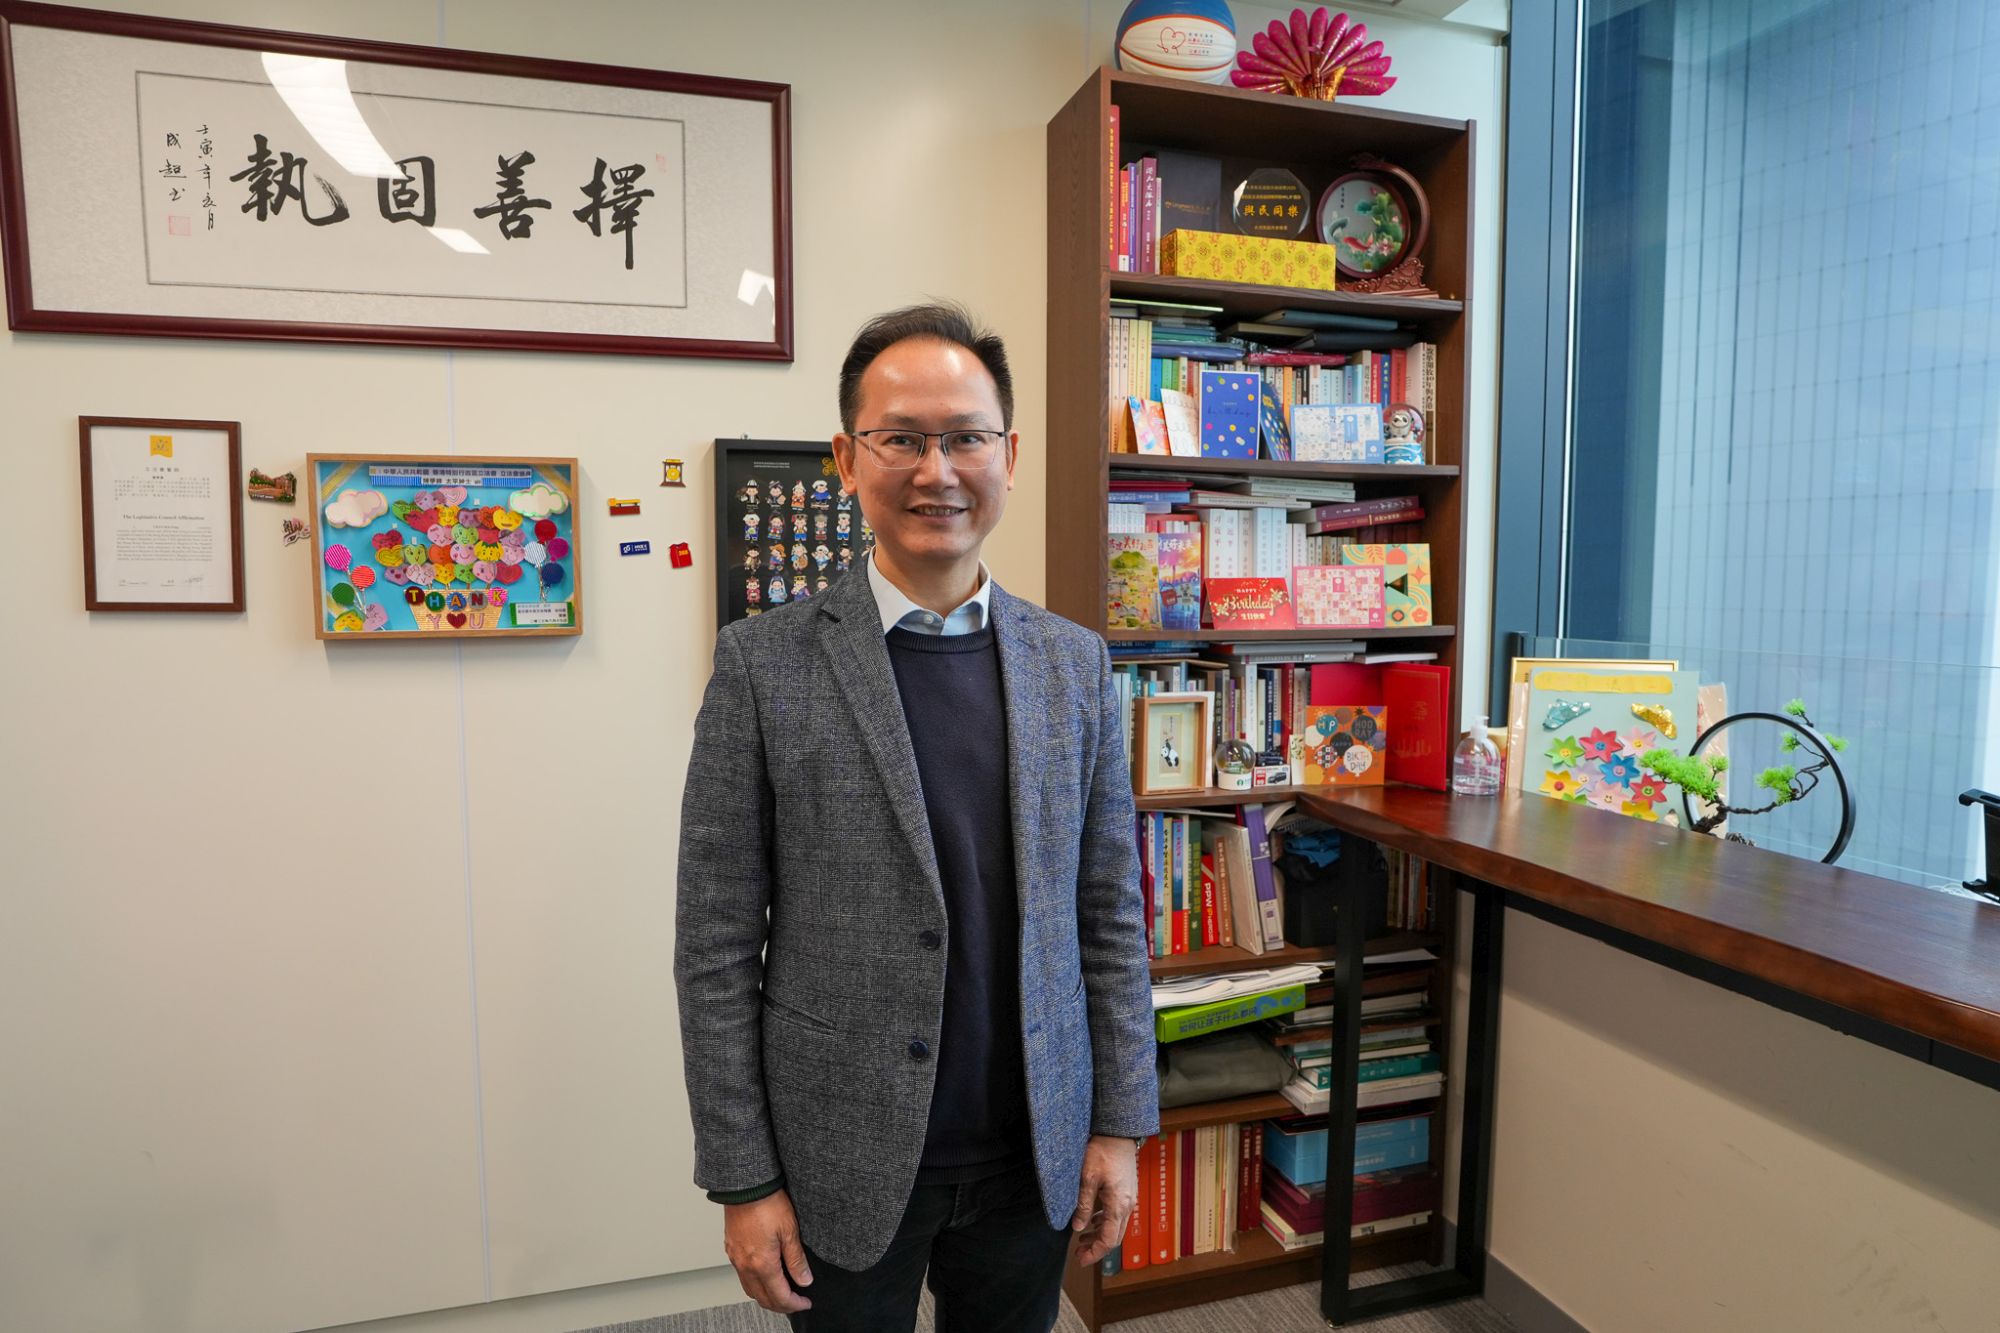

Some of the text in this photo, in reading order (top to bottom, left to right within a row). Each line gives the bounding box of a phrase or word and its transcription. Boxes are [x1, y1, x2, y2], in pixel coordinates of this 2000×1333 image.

[408, 590, 503, 608] THANK
[1223, 594, 1274, 616] Birthday
[1204, 883, 1213, 907] PPW
